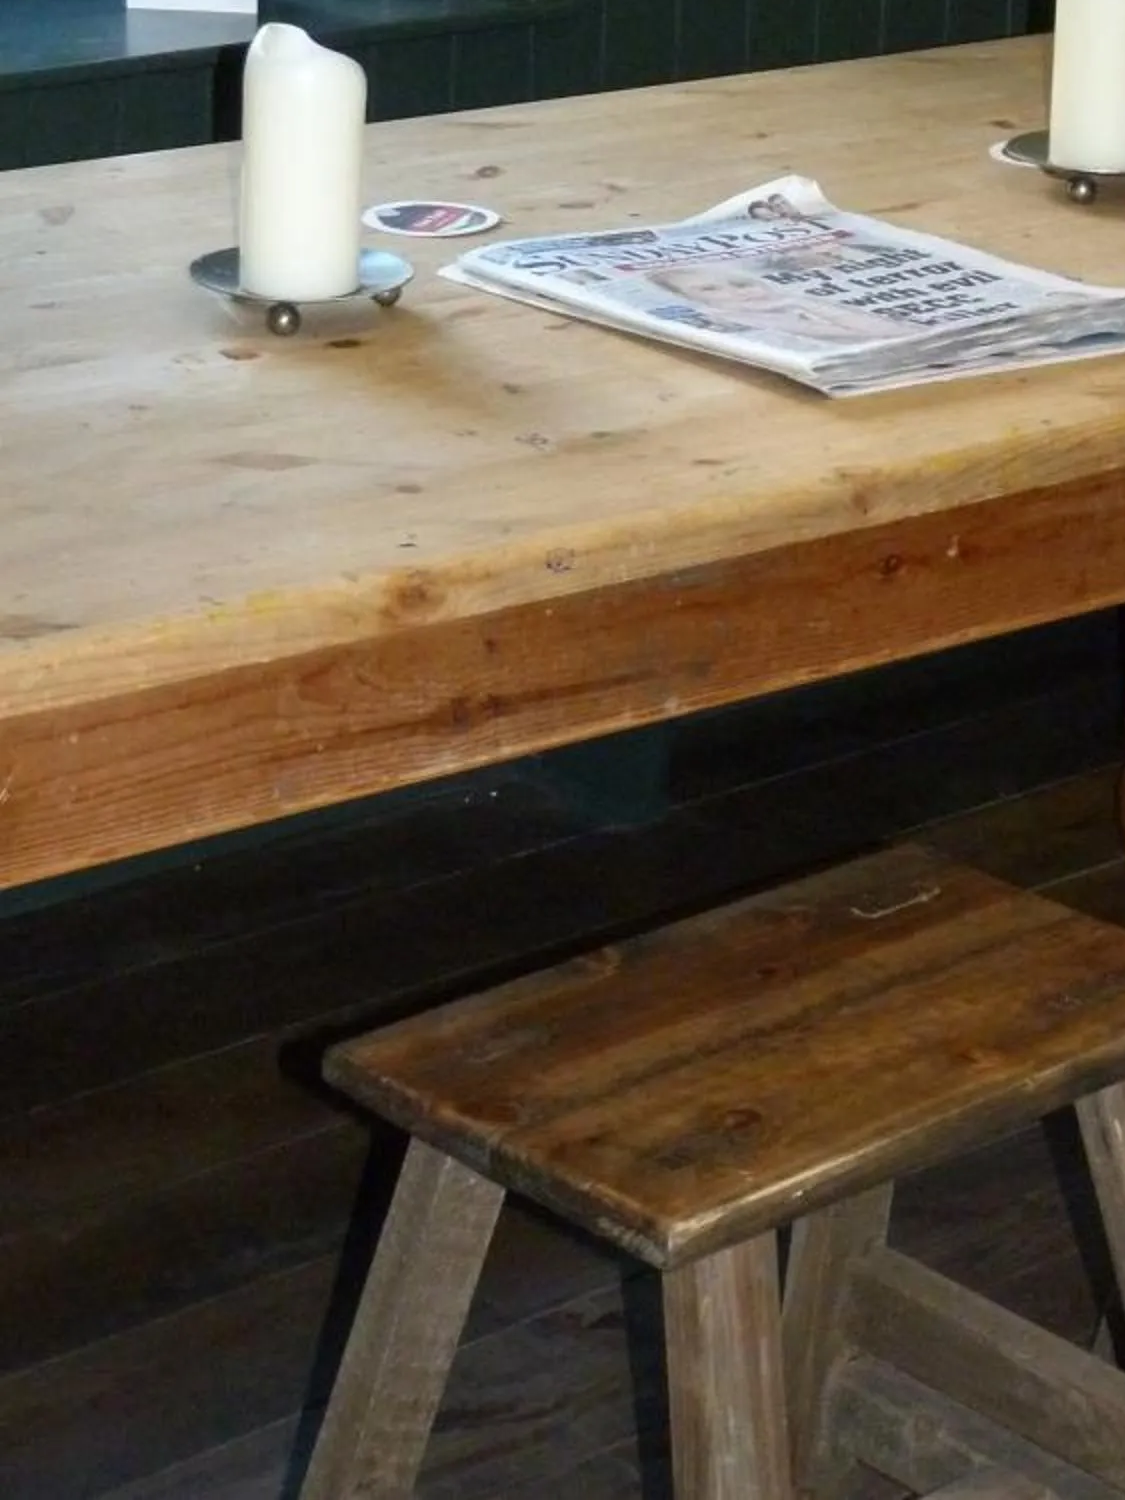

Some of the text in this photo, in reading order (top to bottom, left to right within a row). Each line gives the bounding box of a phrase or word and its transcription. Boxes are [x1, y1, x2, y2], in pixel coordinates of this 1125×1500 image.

[700, 215, 835, 248] POST
[761, 269, 832, 284] My
[829, 249, 933, 274] night
[803, 260, 964, 297] of terror
[838, 269, 1004, 307] with evil
